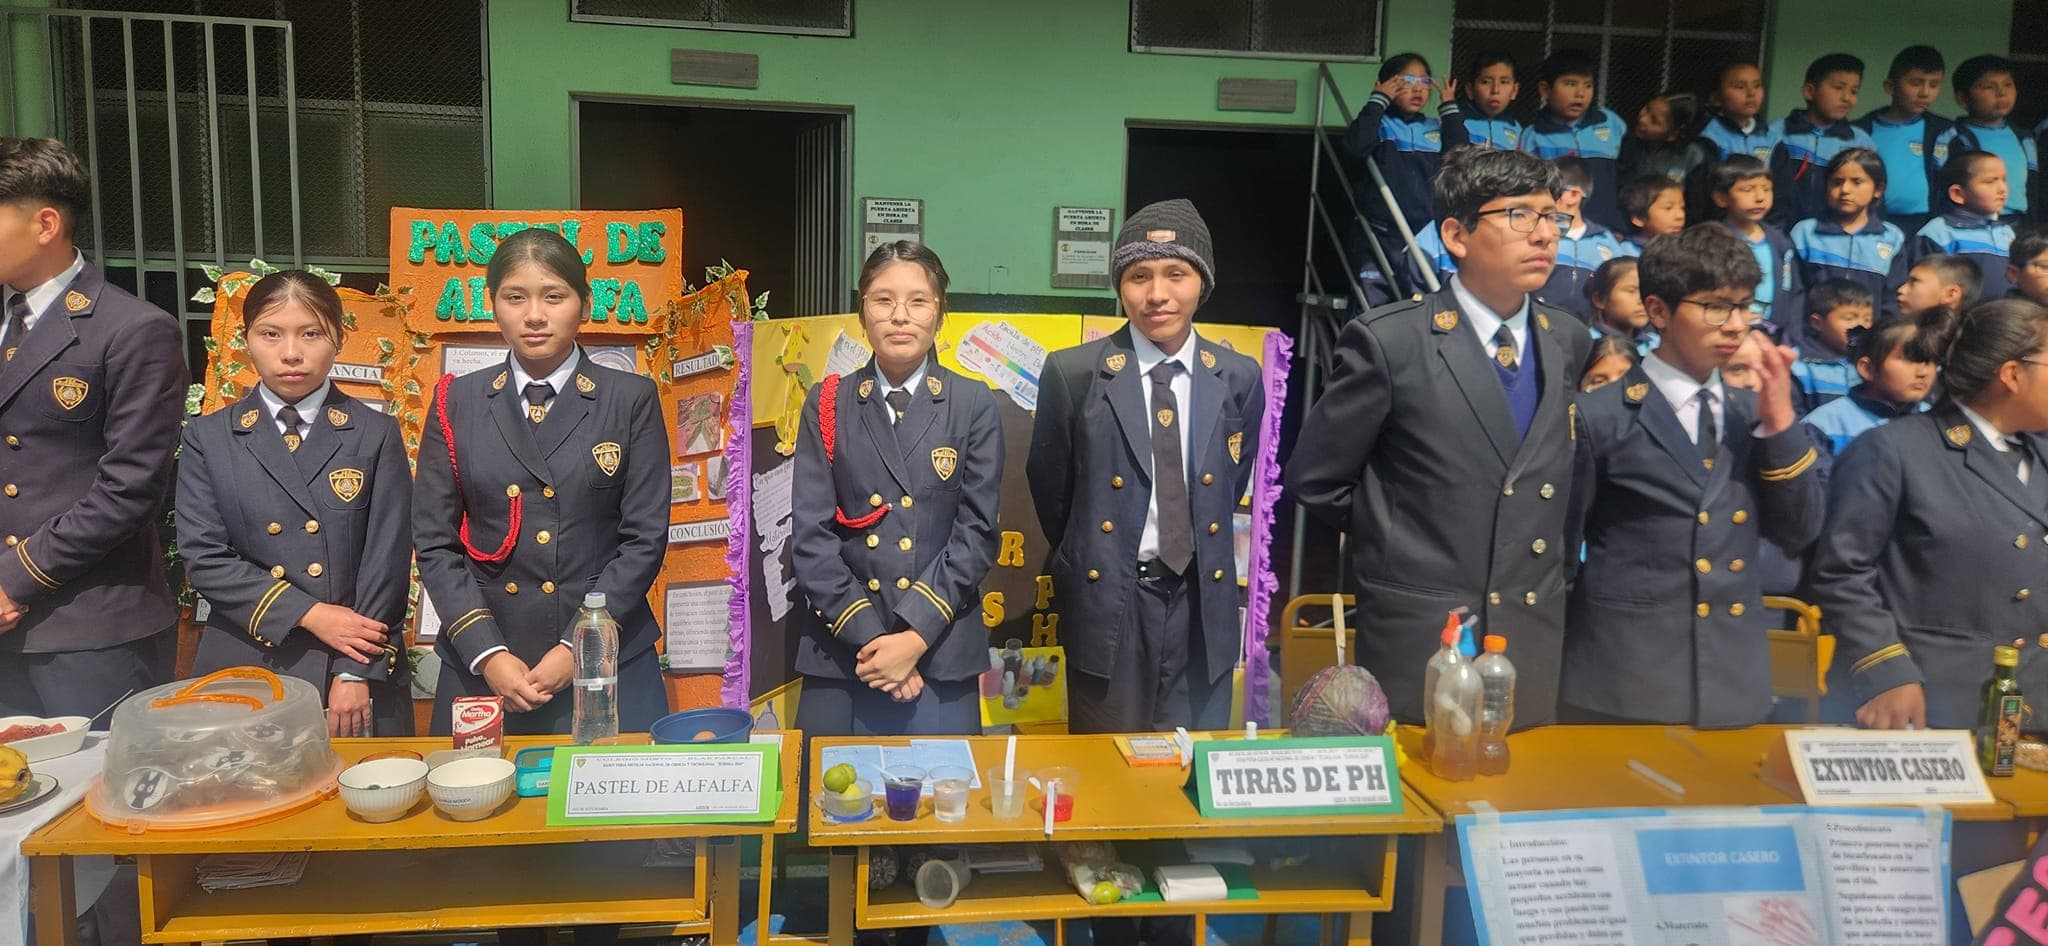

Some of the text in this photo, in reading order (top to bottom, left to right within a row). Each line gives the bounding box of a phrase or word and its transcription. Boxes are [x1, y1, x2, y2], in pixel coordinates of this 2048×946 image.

[408, 219, 667, 265] PASL DE
[435, 276, 648, 323] ALFA
[461, 710, 492, 719] Martha
[1216, 765, 1386, 795] TIRAS DE PH
[1809, 757, 1966, 782] EXTINTOR CASERO
[574, 778, 754, 795] PASTEL DE ALFALFA
[1664, 849, 1781, 865] EXTINTOR CASERO
